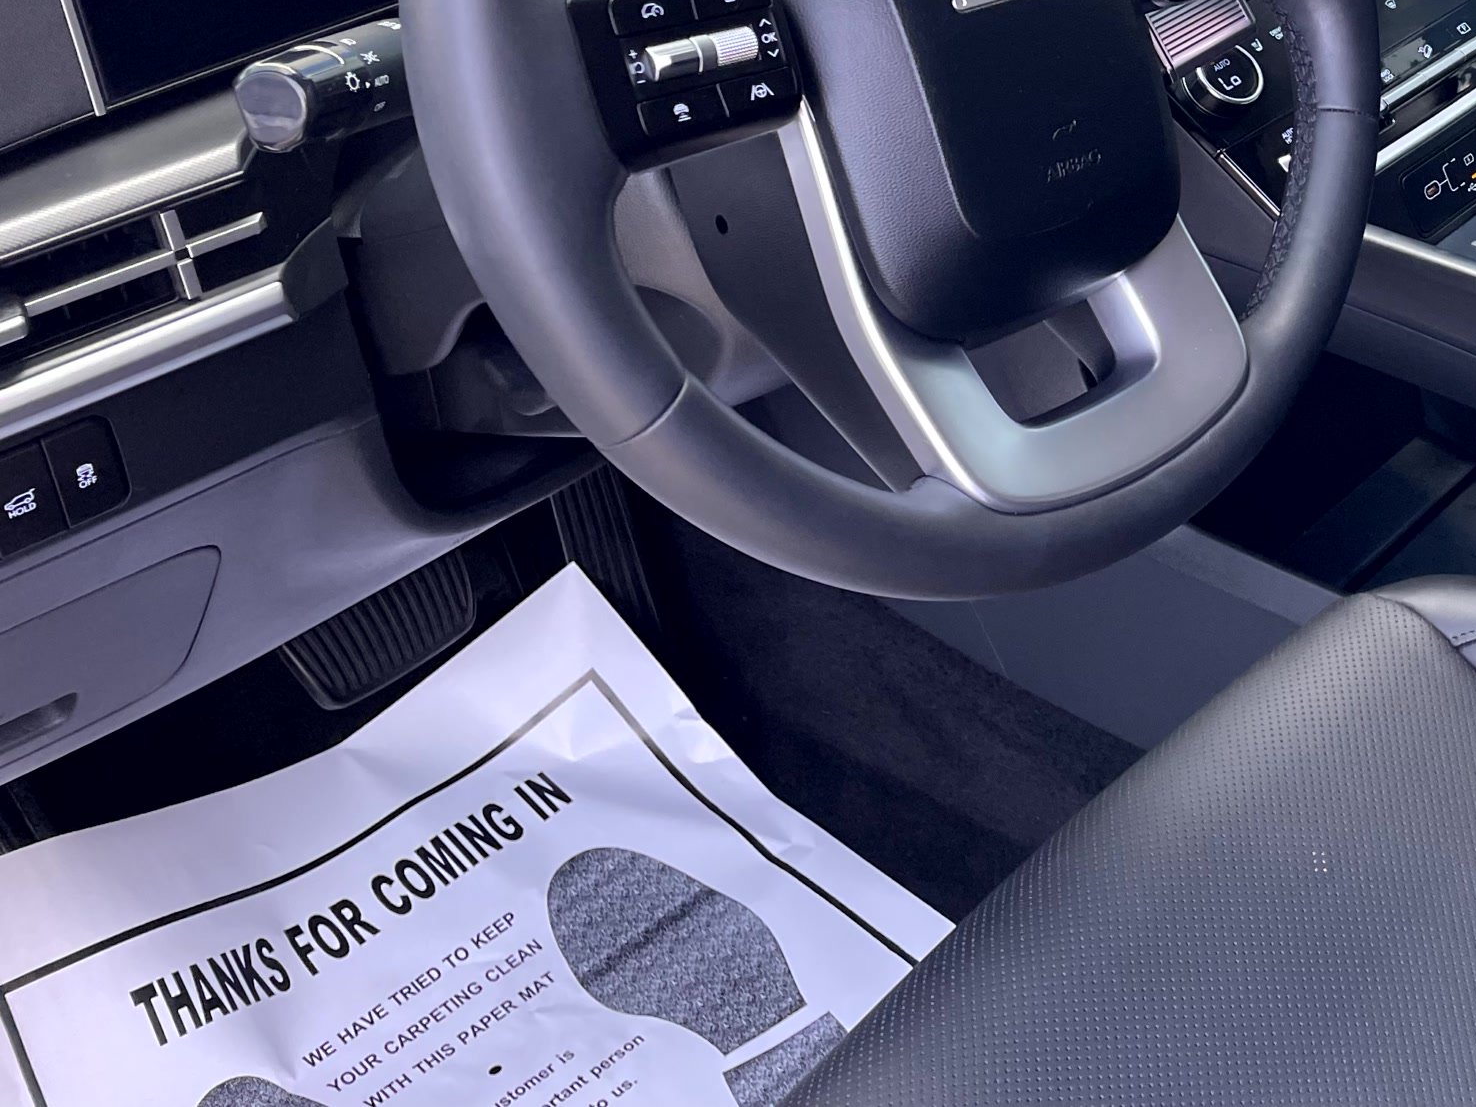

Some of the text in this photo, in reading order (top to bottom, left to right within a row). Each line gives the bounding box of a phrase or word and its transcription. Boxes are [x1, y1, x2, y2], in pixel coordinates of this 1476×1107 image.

[760, 31, 778, 44] OK
[1213, 58, 1231, 72] AUTO
[1046, 148, 1103, 183] AIRBAG
[78, 475, 97, 489] OFF
[8, 501, 37, 520] HOLD
[129, 771, 574, 1047] THANKS FOR COMING IN
[302, 911, 515, 1068] WE HAVE TRIED TO KEEP
[326, 938, 544, 1094] YOUR CARPETING CLEAN
[362, 970, 555, 1107] WITH THIS PAPER MAT
[555, 1049, 576, 1064] is
[589, 1034, 646, 1080] person
[611, 1079, 638, 1098] us.
